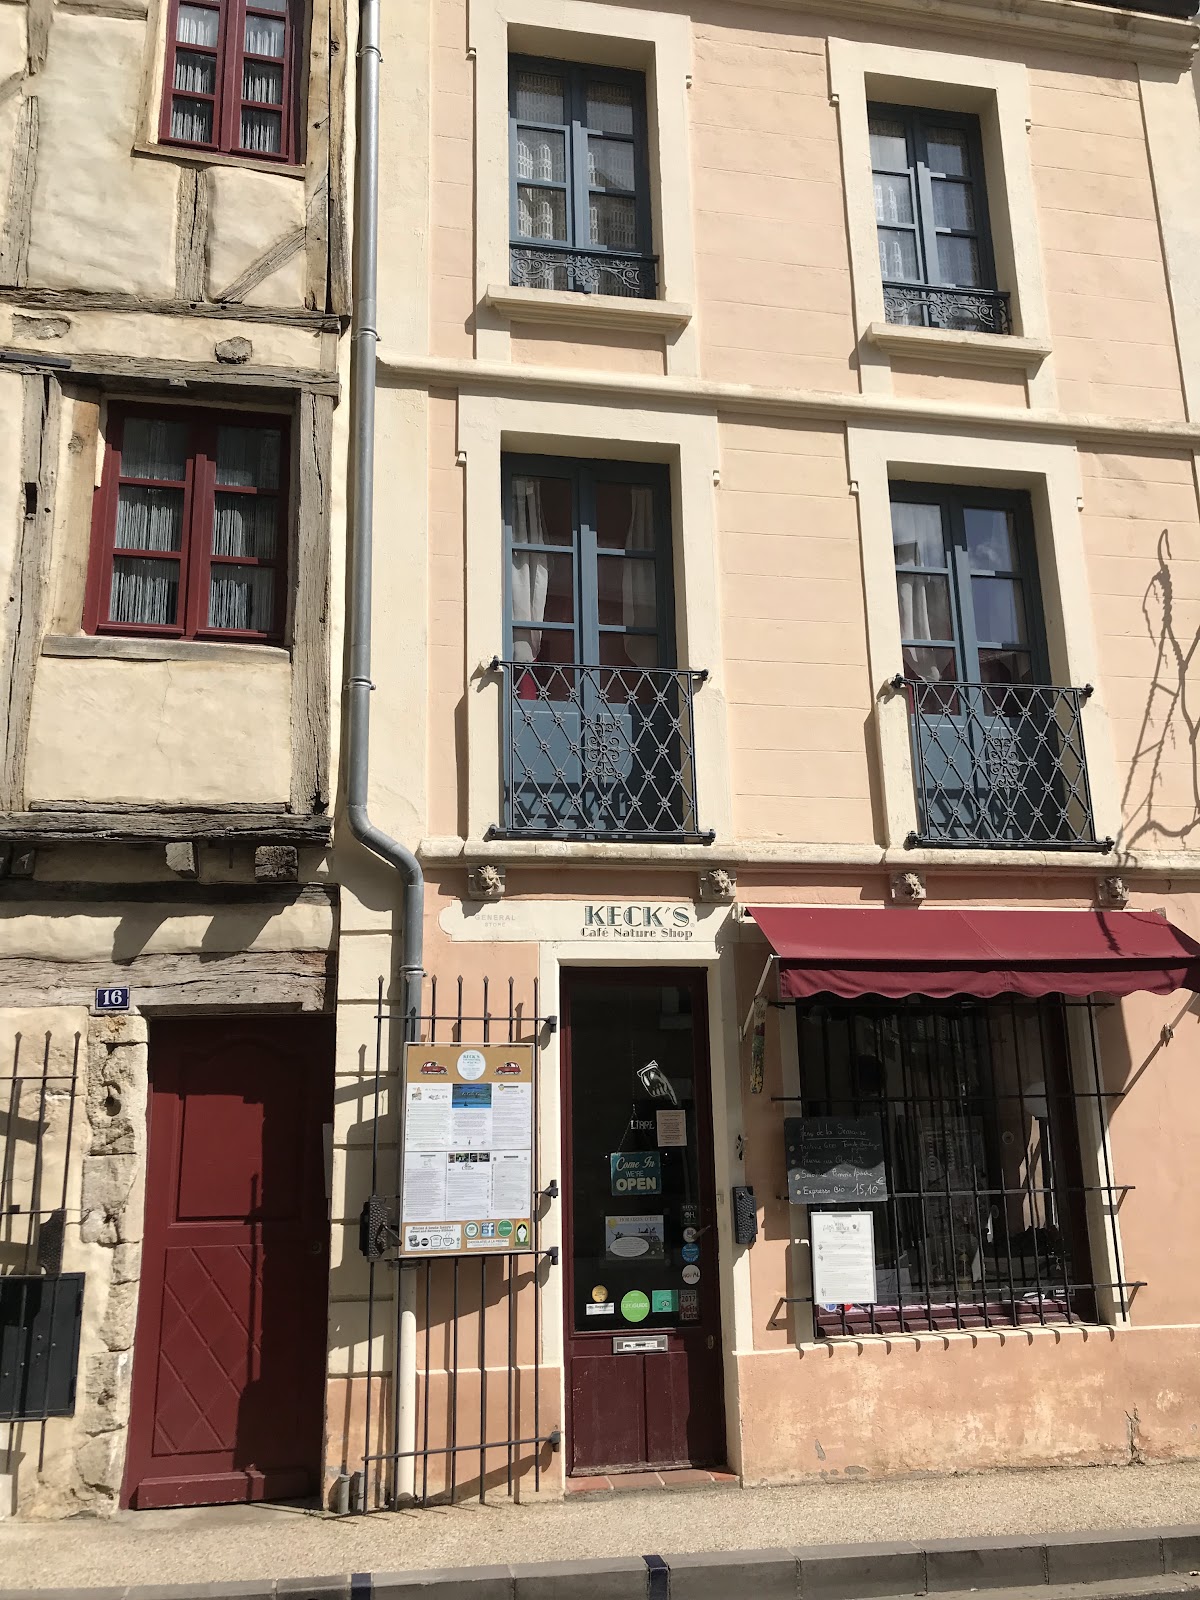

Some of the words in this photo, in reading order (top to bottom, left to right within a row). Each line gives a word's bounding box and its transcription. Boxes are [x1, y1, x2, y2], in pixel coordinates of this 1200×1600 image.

[584, 905, 690, 927] KECK'S
[580, 927, 609, 938] Café
[613, 927, 656, 938] Nature
[660, 927, 693, 941] Shop
[103, 990, 123, 1005] 16
[616, 1156, 640, 1171] Come
[642, 1156, 655, 1168] In
[625, 1170, 645, 1178] WE'RE
[615, 1176, 657, 1192] OPEN
